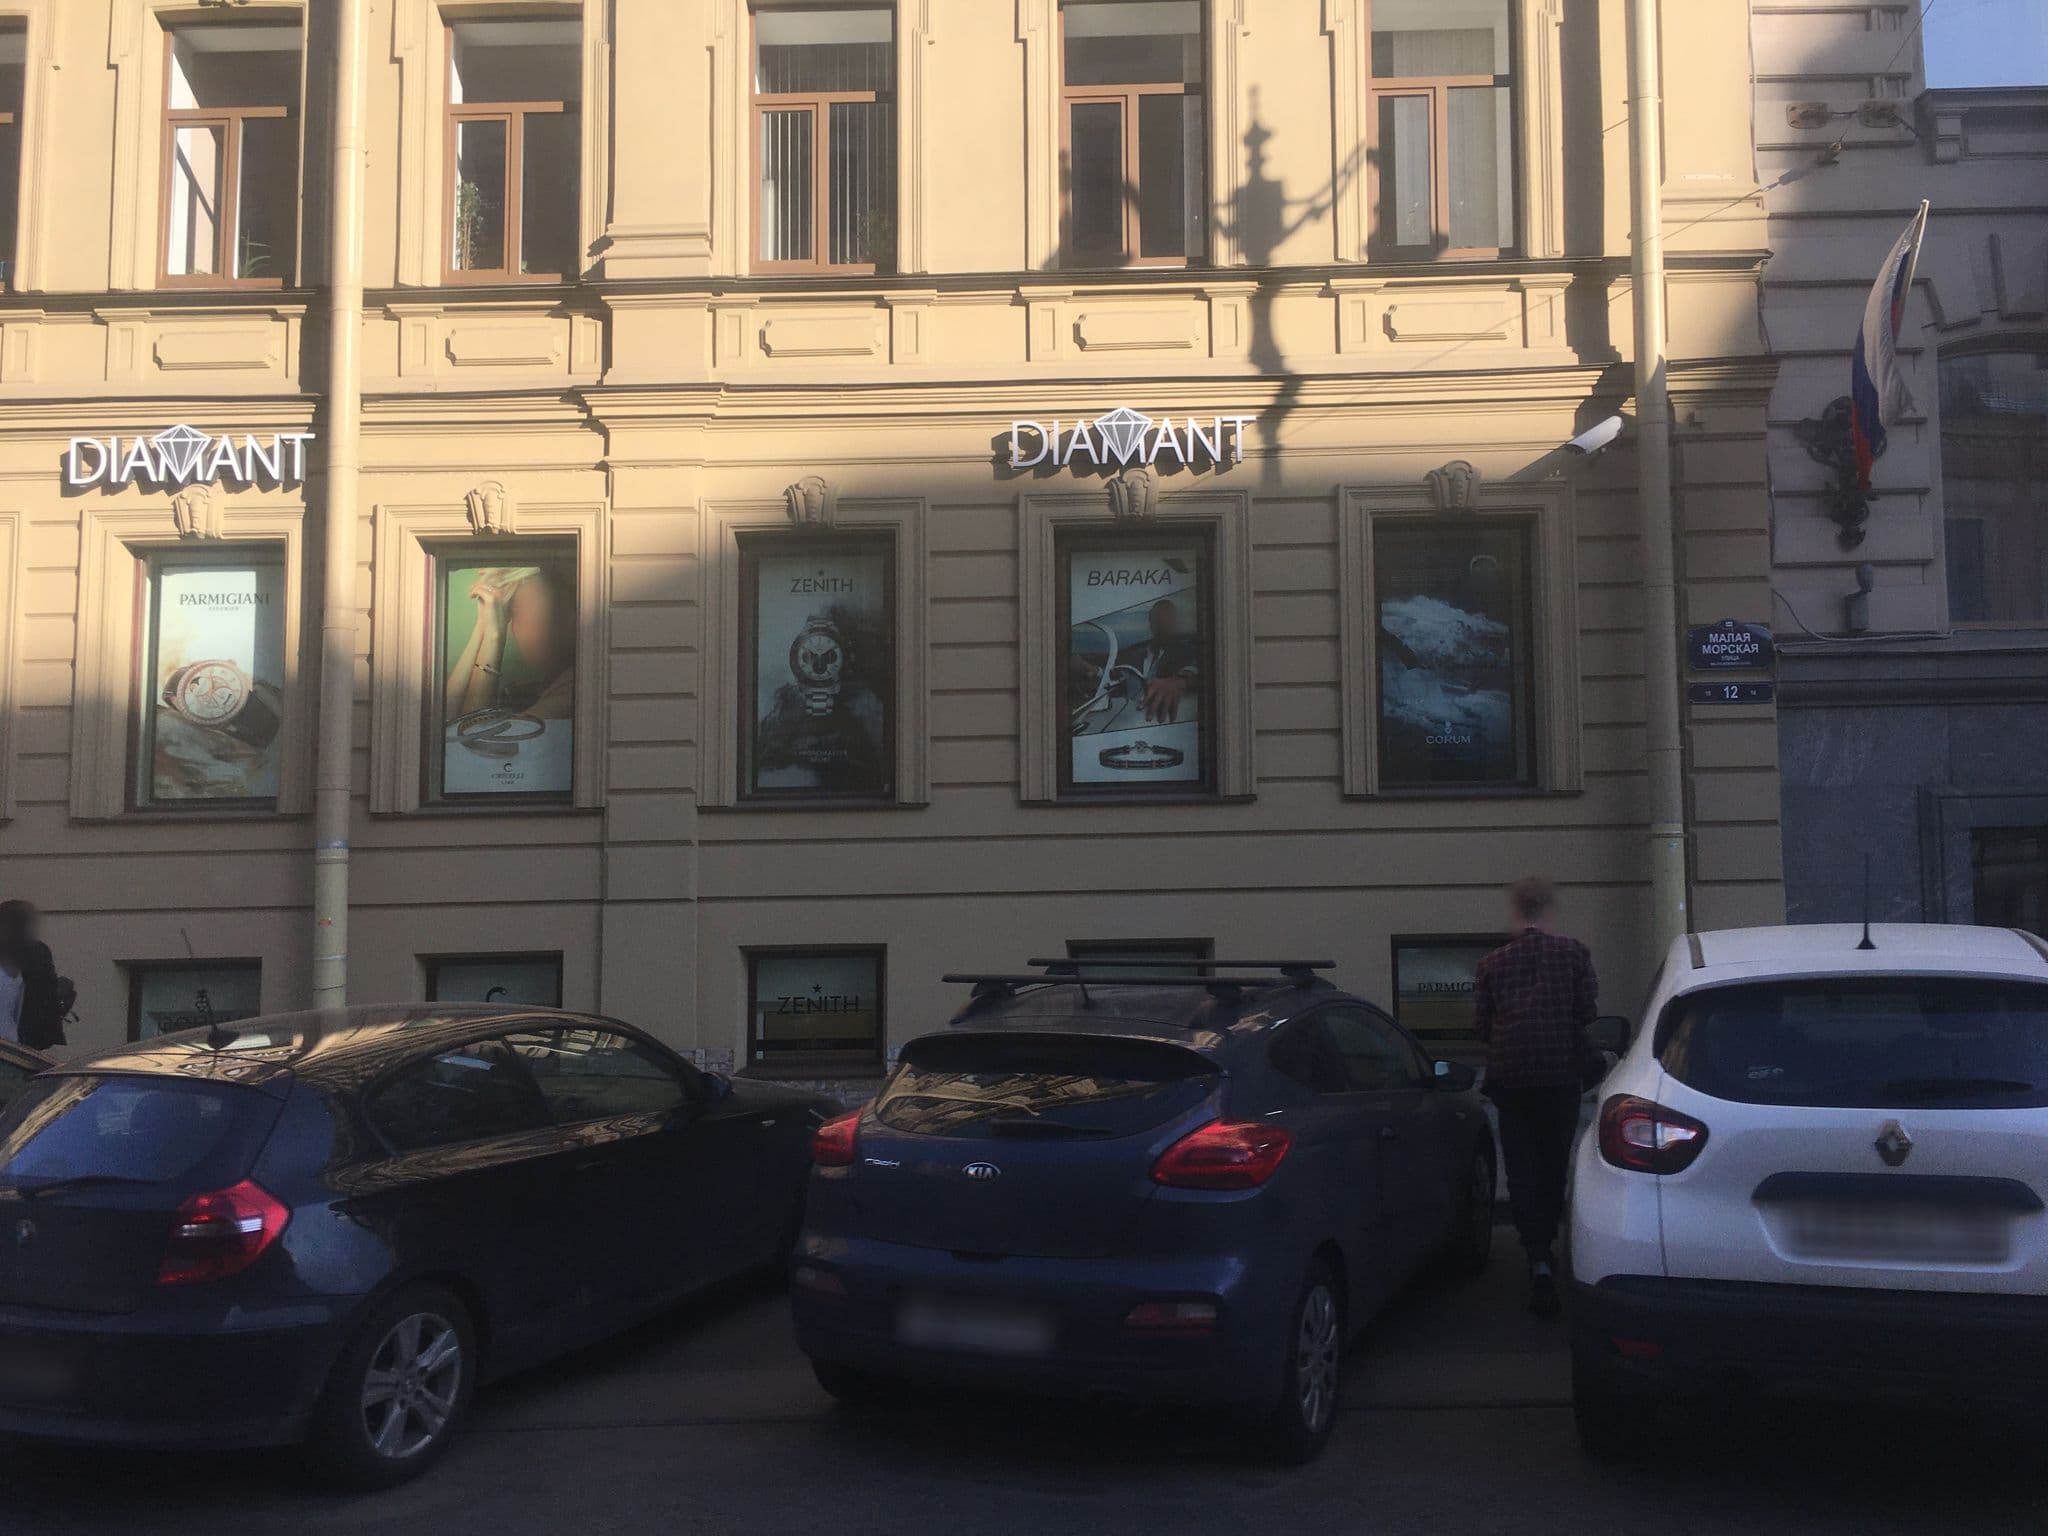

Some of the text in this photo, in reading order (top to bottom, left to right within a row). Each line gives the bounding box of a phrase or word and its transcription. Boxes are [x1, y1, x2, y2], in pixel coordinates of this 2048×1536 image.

[1012, 406, 1256, 467] DIAMANT
[69, 424, 316, 485] DIAMANT
[1087, 569, 1172, 586] BARAKA
[791, 578, 853, 593] ZENITH
[179, 592, 270, 606] PARMIGIANI
[1709, 632, 1751, 643] МАЛАЯ
[1702, 643, 1759, 654] МОРСКАЯ
[1723, 685, 1739, 699] 12
[1425, 735, 1471, 745] CORUM
[777, 995, 859, 1015] ZENITH
